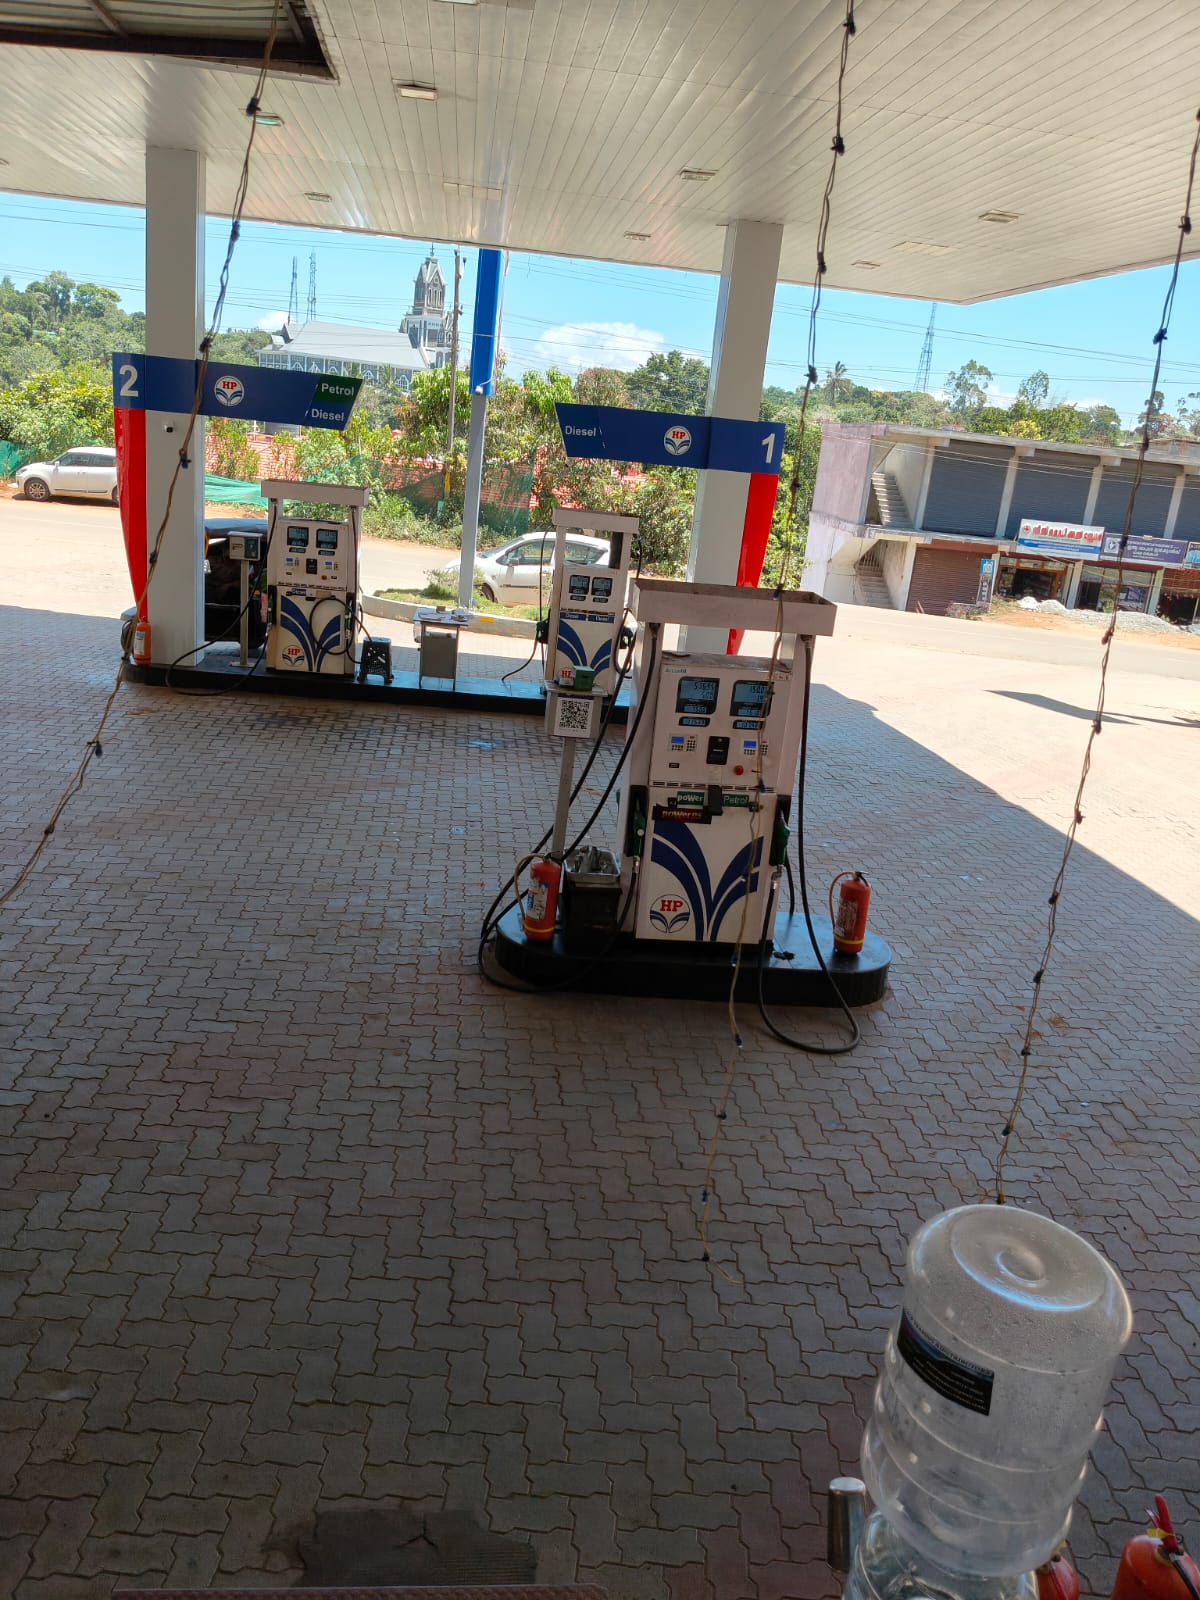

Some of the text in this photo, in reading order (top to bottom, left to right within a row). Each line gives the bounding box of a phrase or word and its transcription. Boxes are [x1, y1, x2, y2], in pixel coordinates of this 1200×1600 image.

[119, 364, 139, 398] 2
[222, 380, 238, 390] HP
[321, 383, 355, 396] Petrol
[311, 408, 345, 421] Diesel
[564, 425, 597, 437] Diesel
[671, 430, 686, 440] HP
[761, 433, 776, 464] 1
[287, 647, 301, 656] HP
[723, 796, 749, 805] Petrol
[660, 899, 684, 912] HP
